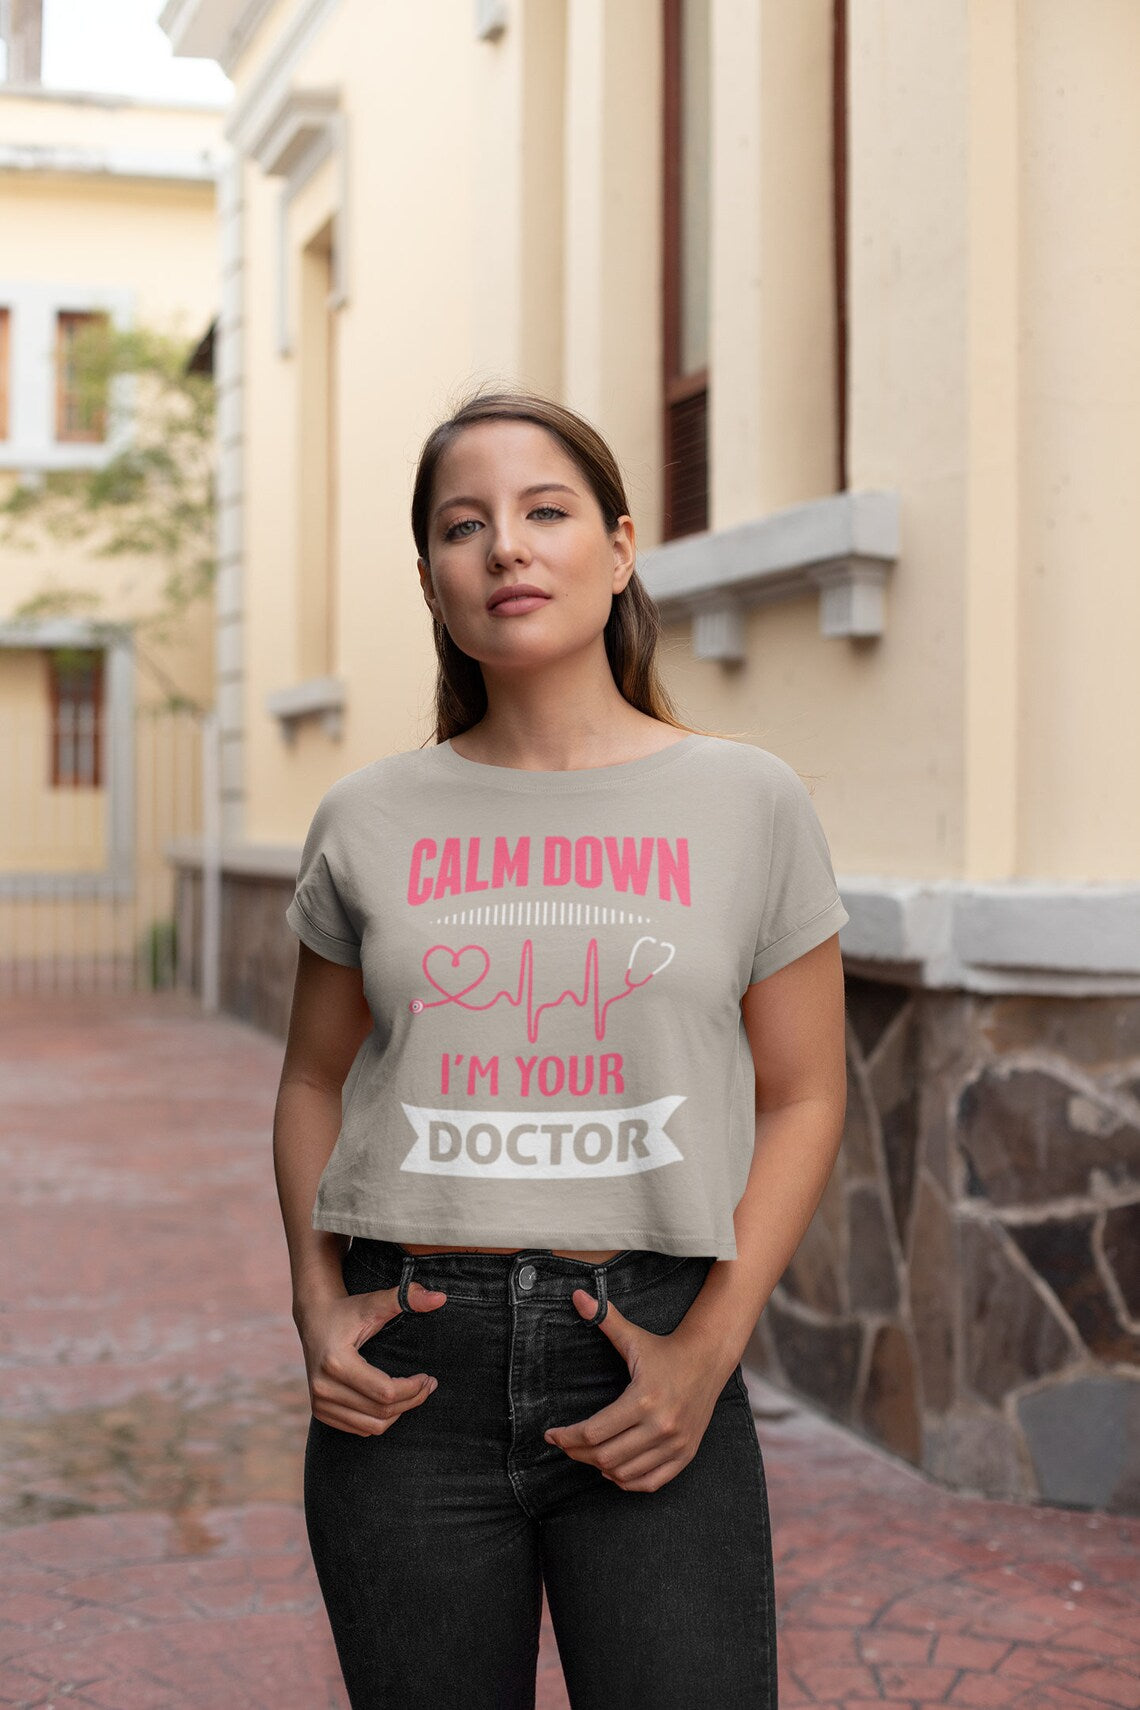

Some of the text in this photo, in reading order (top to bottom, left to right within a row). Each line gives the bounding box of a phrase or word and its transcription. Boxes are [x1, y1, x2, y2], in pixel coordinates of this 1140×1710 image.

[407, 836, 691, 908] CALM DOWN
[441, 1052, 625, 1097] I'M YOUR
[428, 1118, 651, 1166] DOCTOR
